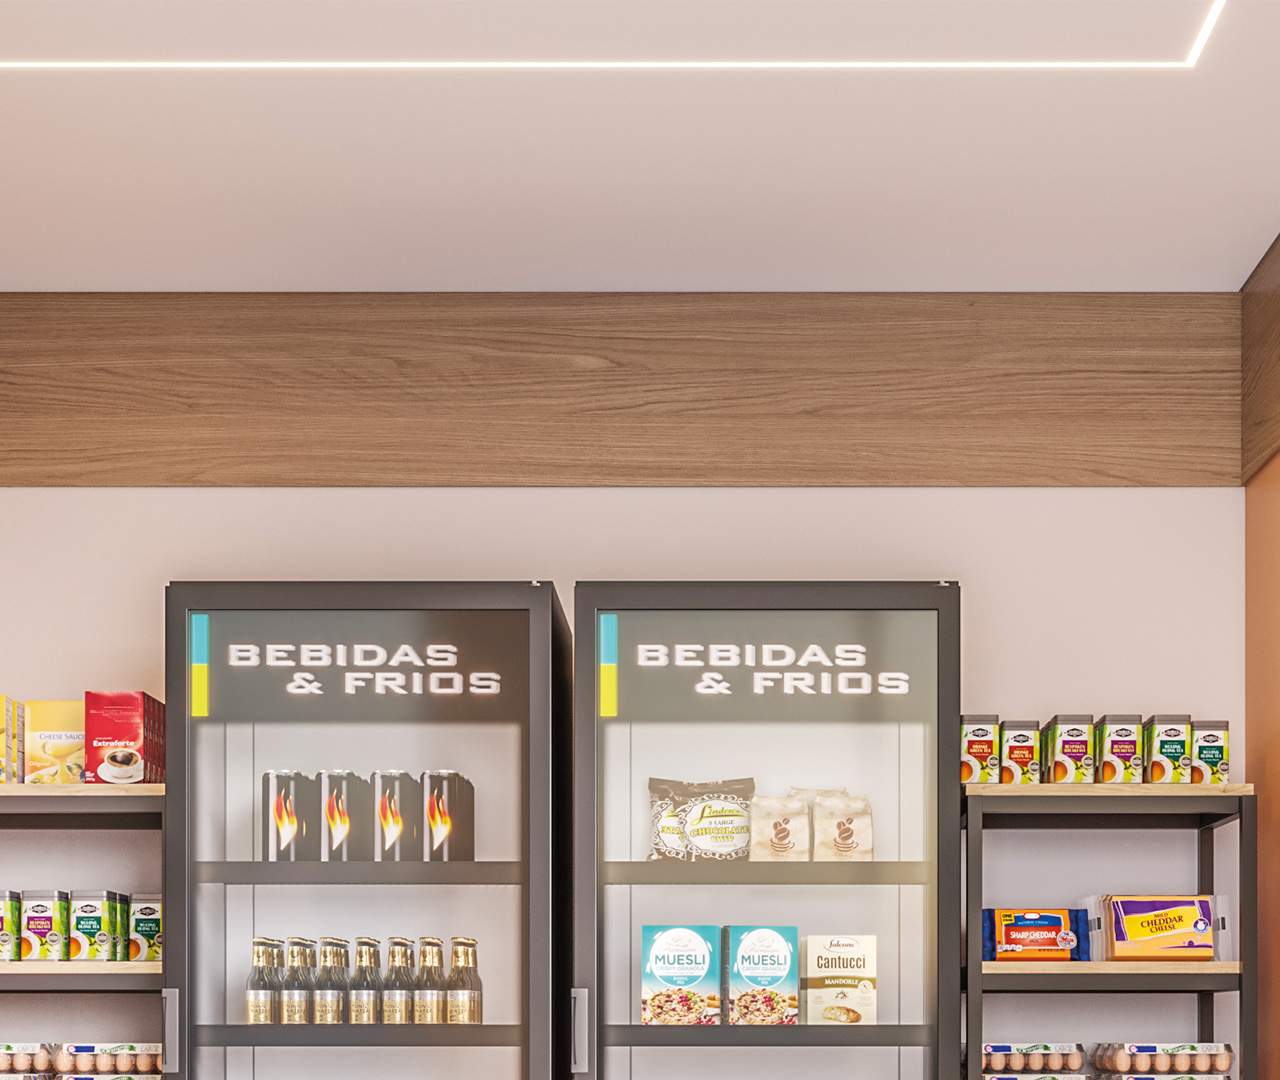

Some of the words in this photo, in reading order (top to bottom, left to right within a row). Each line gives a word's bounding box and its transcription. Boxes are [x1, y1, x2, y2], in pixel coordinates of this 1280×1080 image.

[228, 644, 457, 666] BEBIDAS
[637, 644, 866, 666] BEBIDAS
[286, 672, 323, 694] &
[345, 672, 501, 694] FRIOS
[694, 672, 732, 694] &
[753, 672, 909, 694] FRIOS
[690, 827, 749, 837] CHOCOLATE
[1141, 915, 1184, 927] CHEDDAR
[1150, 924, 1176, 933] CHEESE
[1010, 931, 1029, 939] SHARP
[1030, 931, 1056, 939] CHEDDAR
[655, 955, 705, 965] MUESLI
[741, 955, 786, 965] MUESLI
[817, 955, 865, 969] Cantucci
